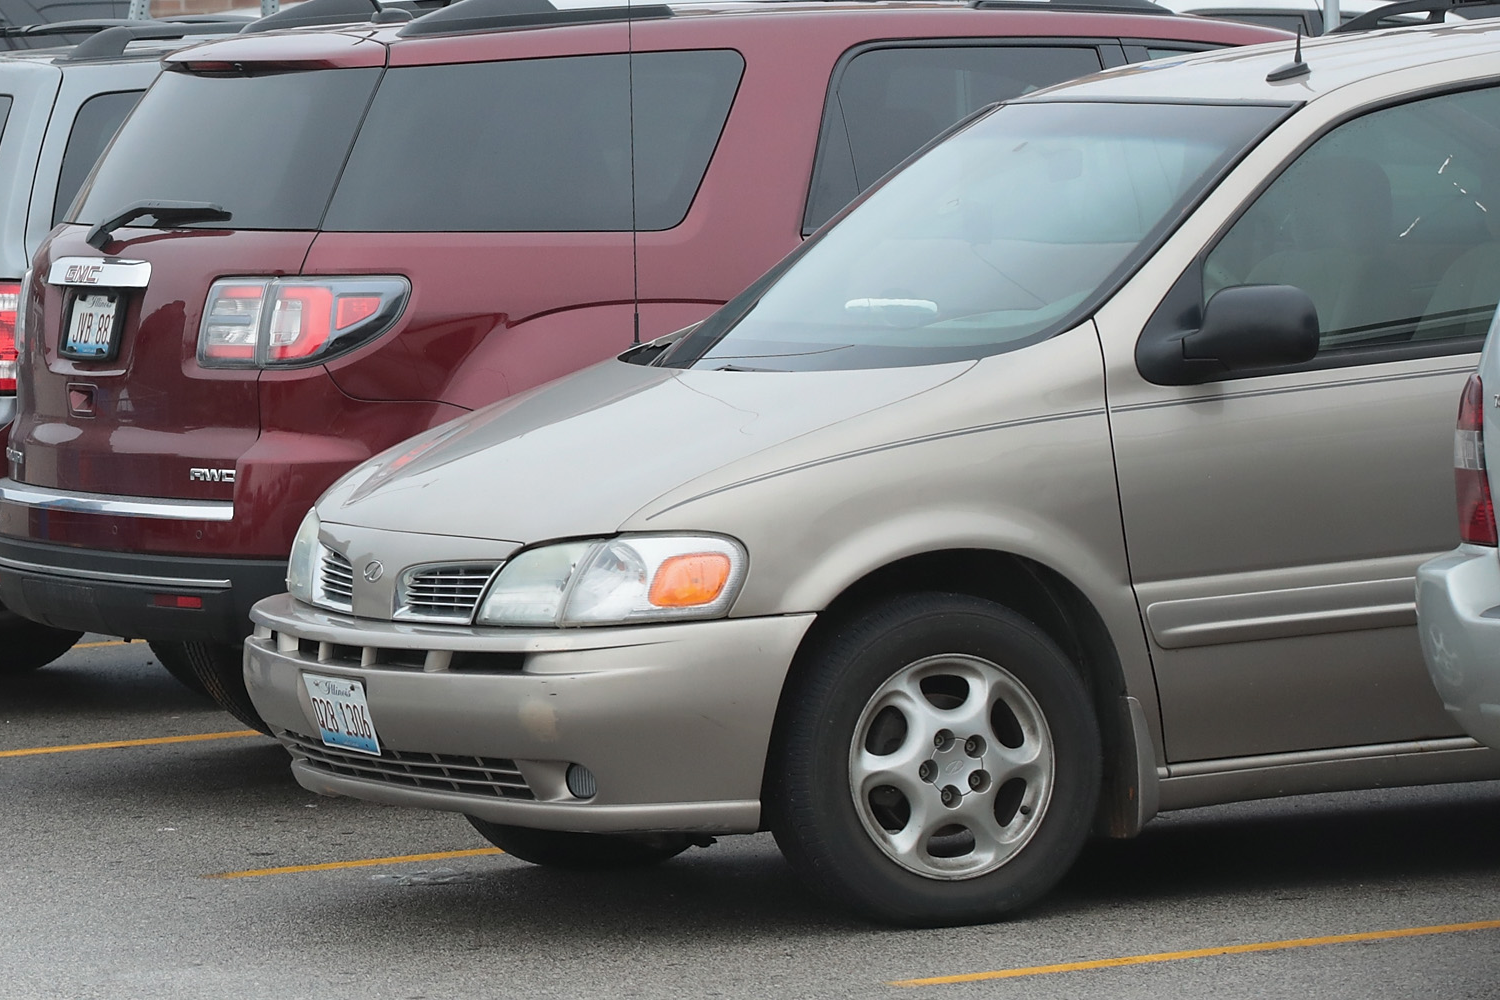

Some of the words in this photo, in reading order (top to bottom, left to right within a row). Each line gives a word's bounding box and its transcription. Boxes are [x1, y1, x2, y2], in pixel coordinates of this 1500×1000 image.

[65, 264, 104, 284] GMC
[85, 295, 113, 309] Illinois
[72, 312, 94, 343] JVB
[190, 467, 237, 483] AWD
[318, 680, 353, 698] Illinois
[312, 697, 340, 734] Q28
[339, 701, 372, 740] 1306
